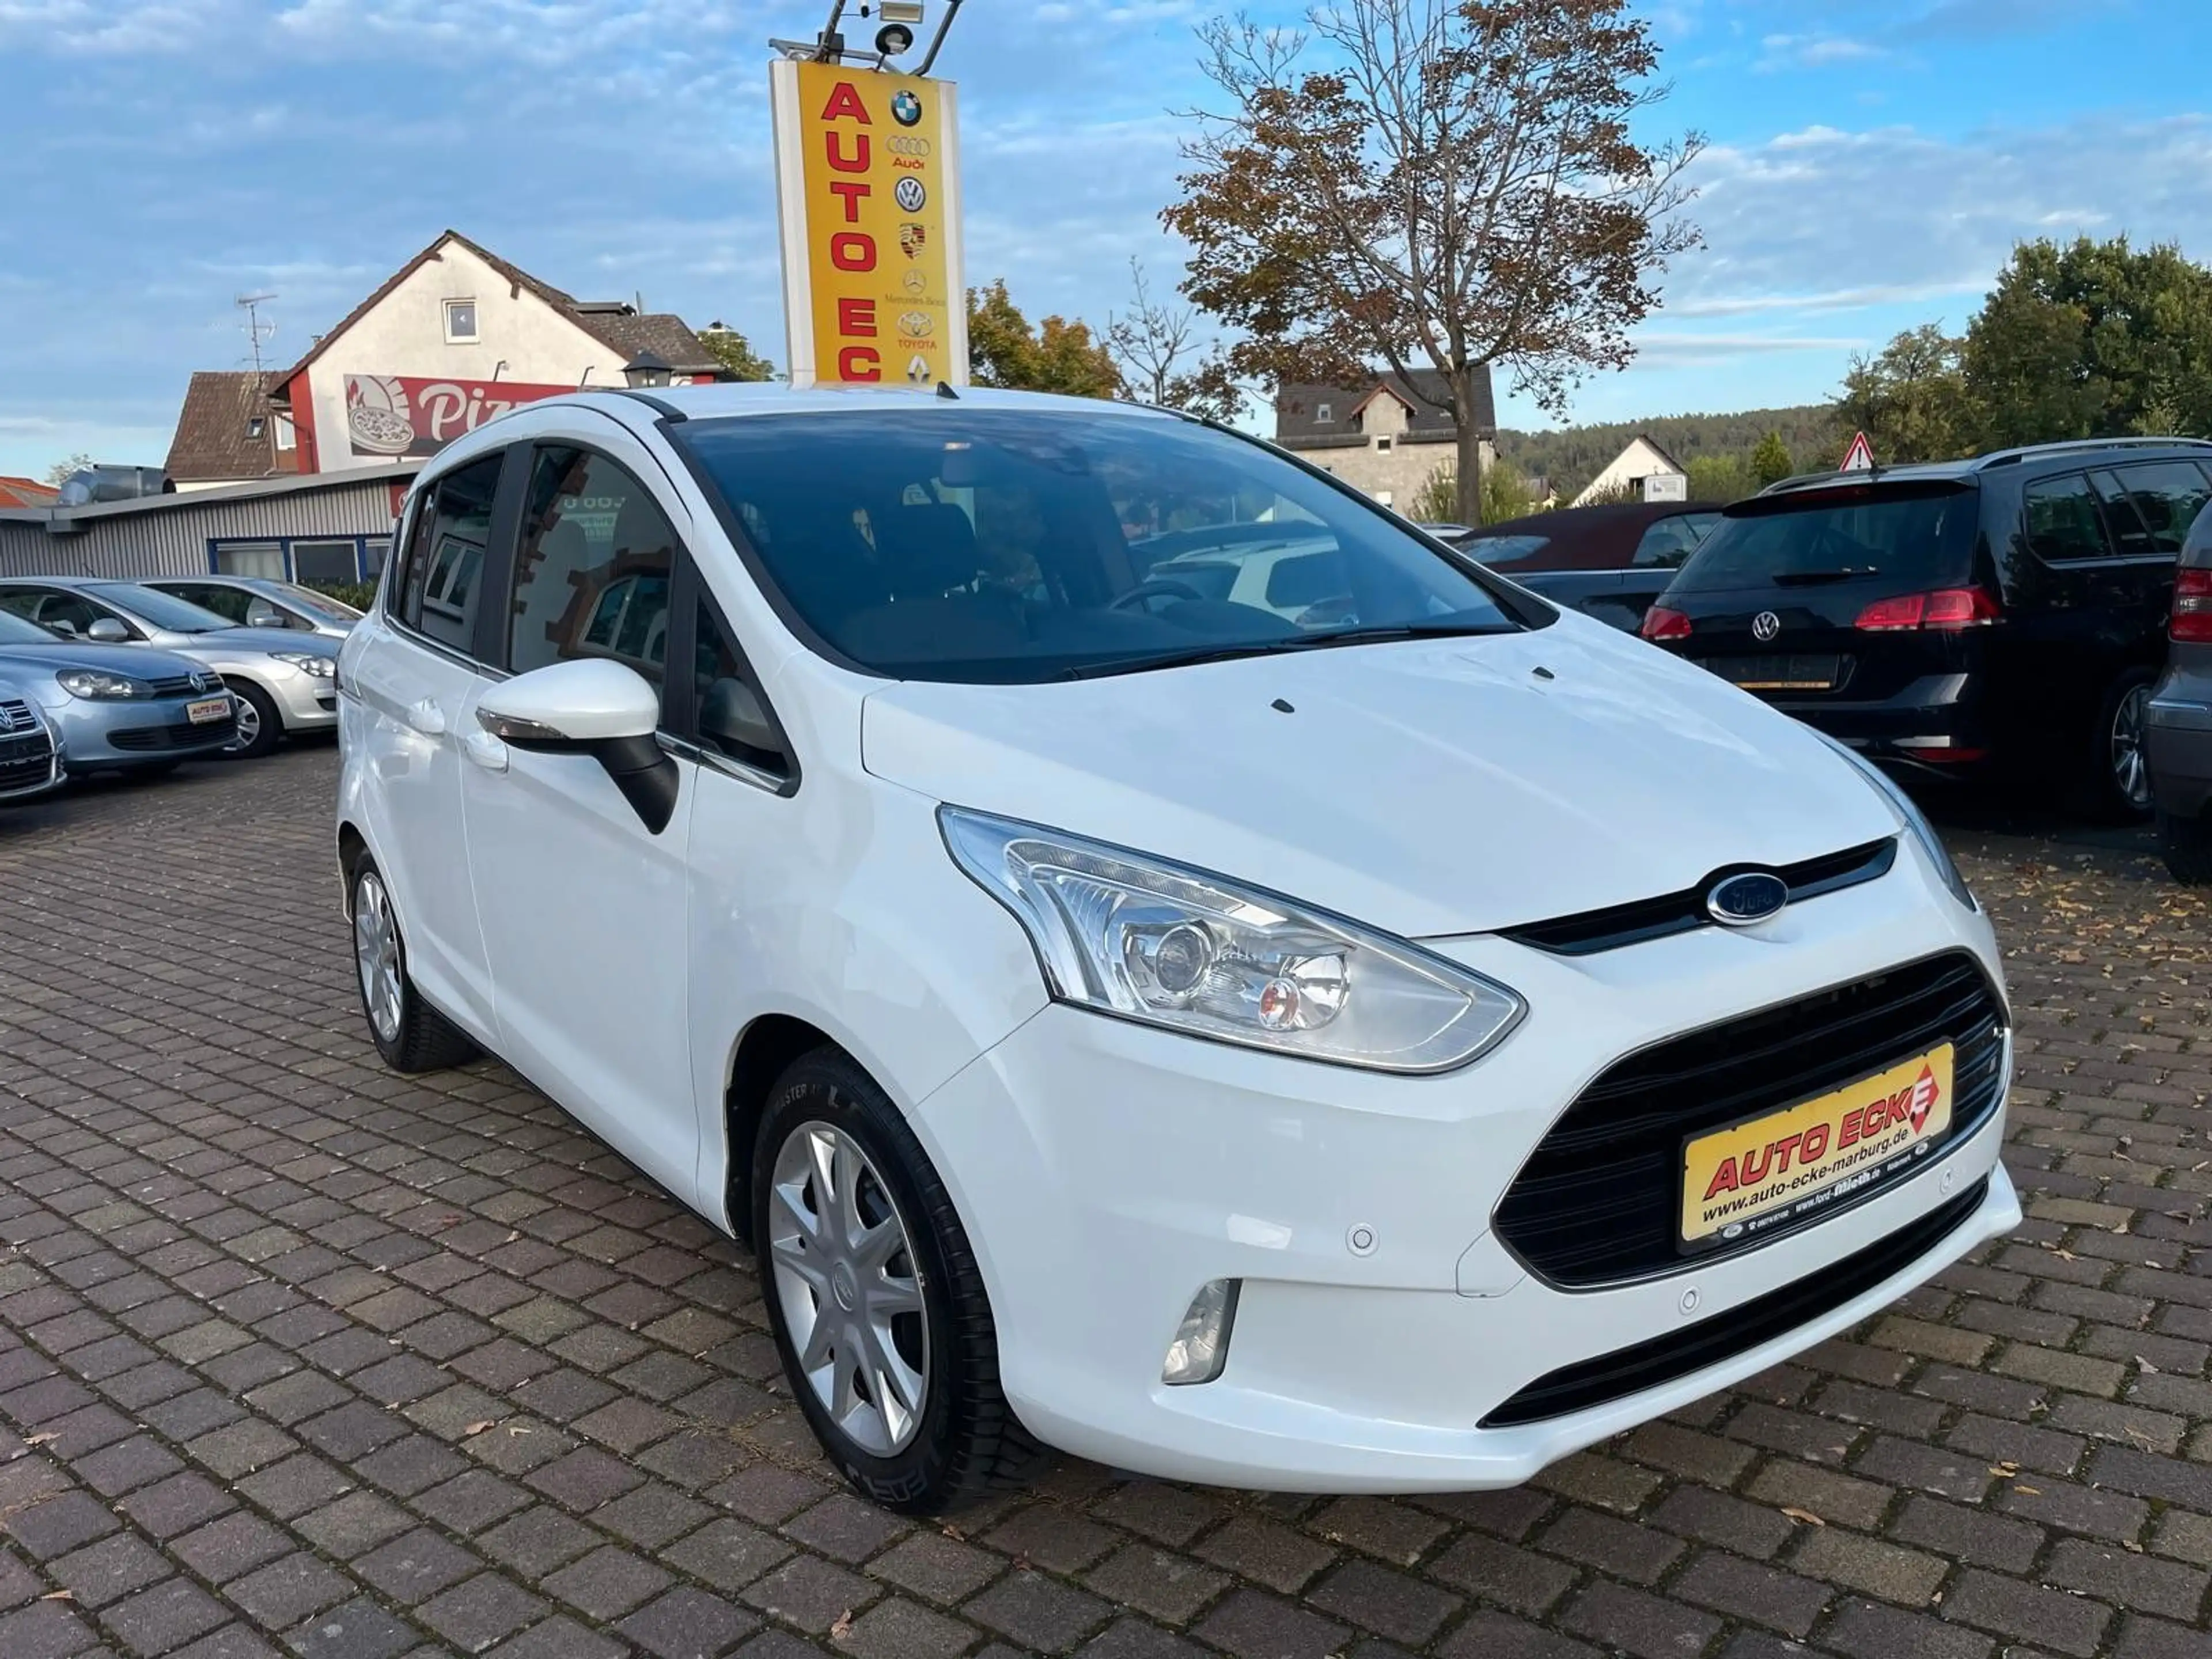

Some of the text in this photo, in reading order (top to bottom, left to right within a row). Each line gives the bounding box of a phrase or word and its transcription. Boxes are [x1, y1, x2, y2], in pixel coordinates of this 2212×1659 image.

[821, 82, 877, 272] AUTO
[898, 338, 937, 350] TOYOTA
[419, 383, 531, 441] Piz
[1703, 1075, 1934, 1202] AUTO ECKE
[1703, 1128, 1909, 1222] www.auto-ecke-marburg.de
